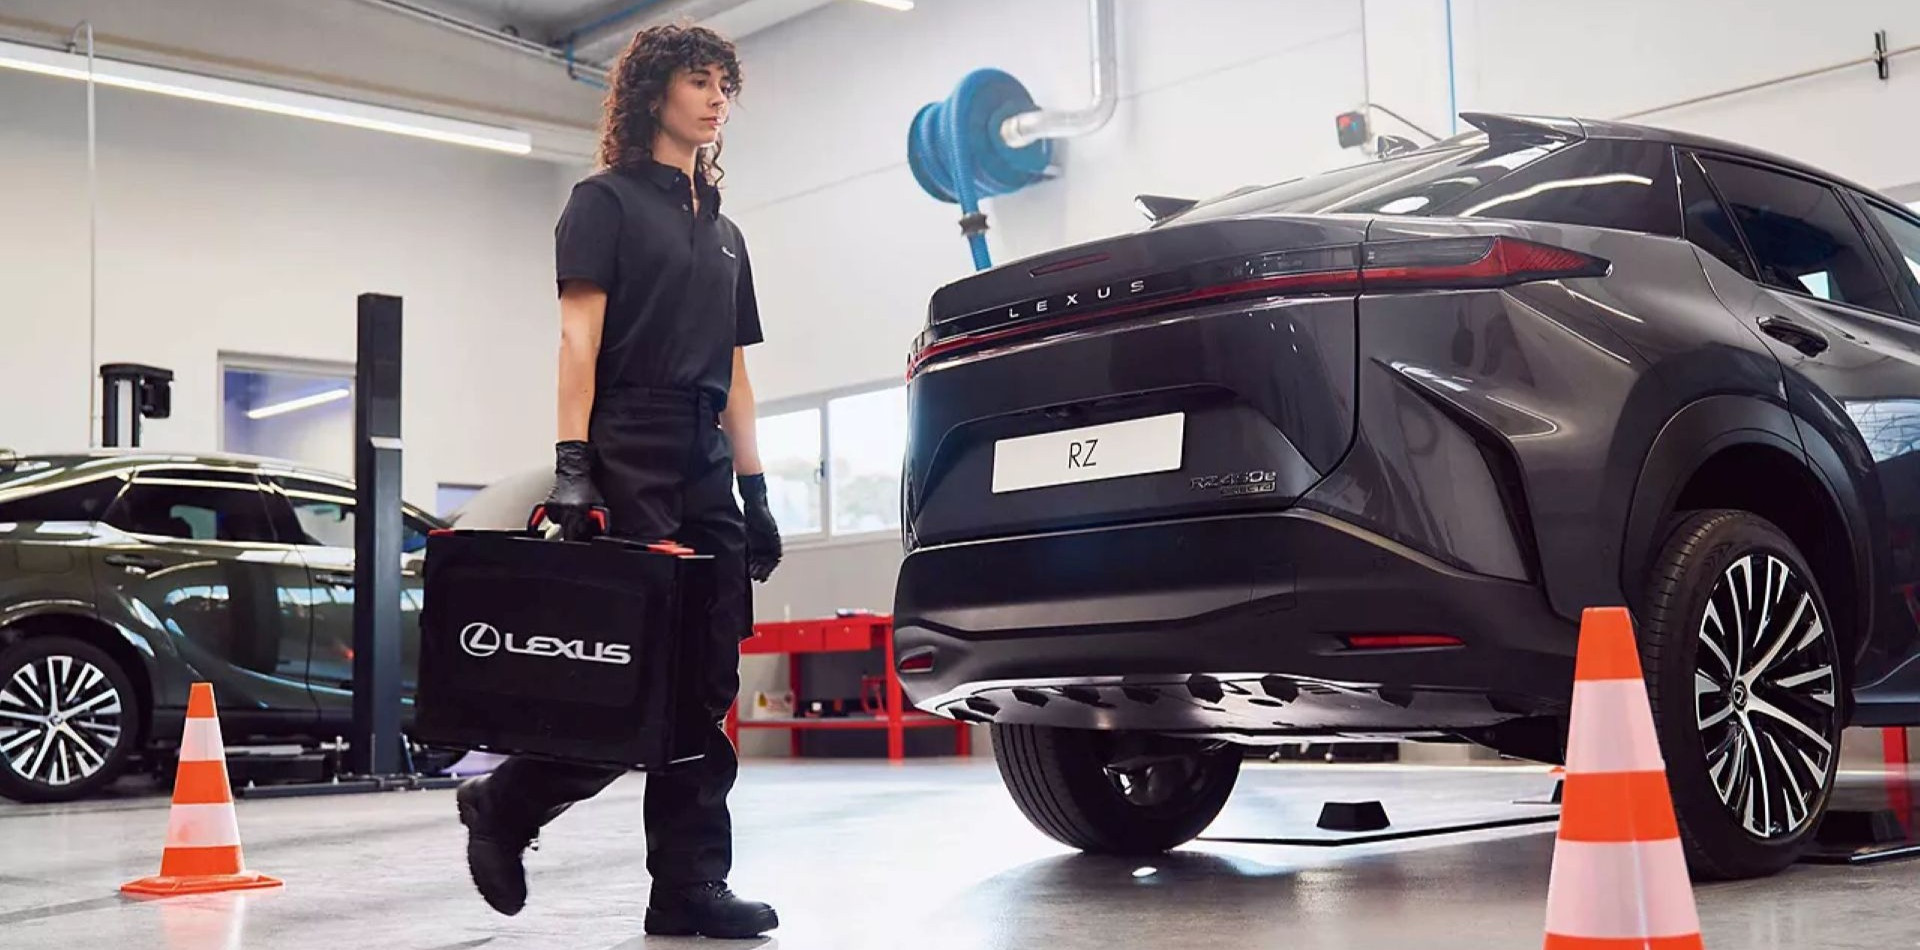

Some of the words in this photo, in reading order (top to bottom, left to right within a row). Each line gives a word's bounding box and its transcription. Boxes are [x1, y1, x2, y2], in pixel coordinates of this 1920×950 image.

[1009, 280, 1144, 318] LEXUS
[1068, 438, 1098, 469] RZ
[505, 633, 631, 664] LEXUS
